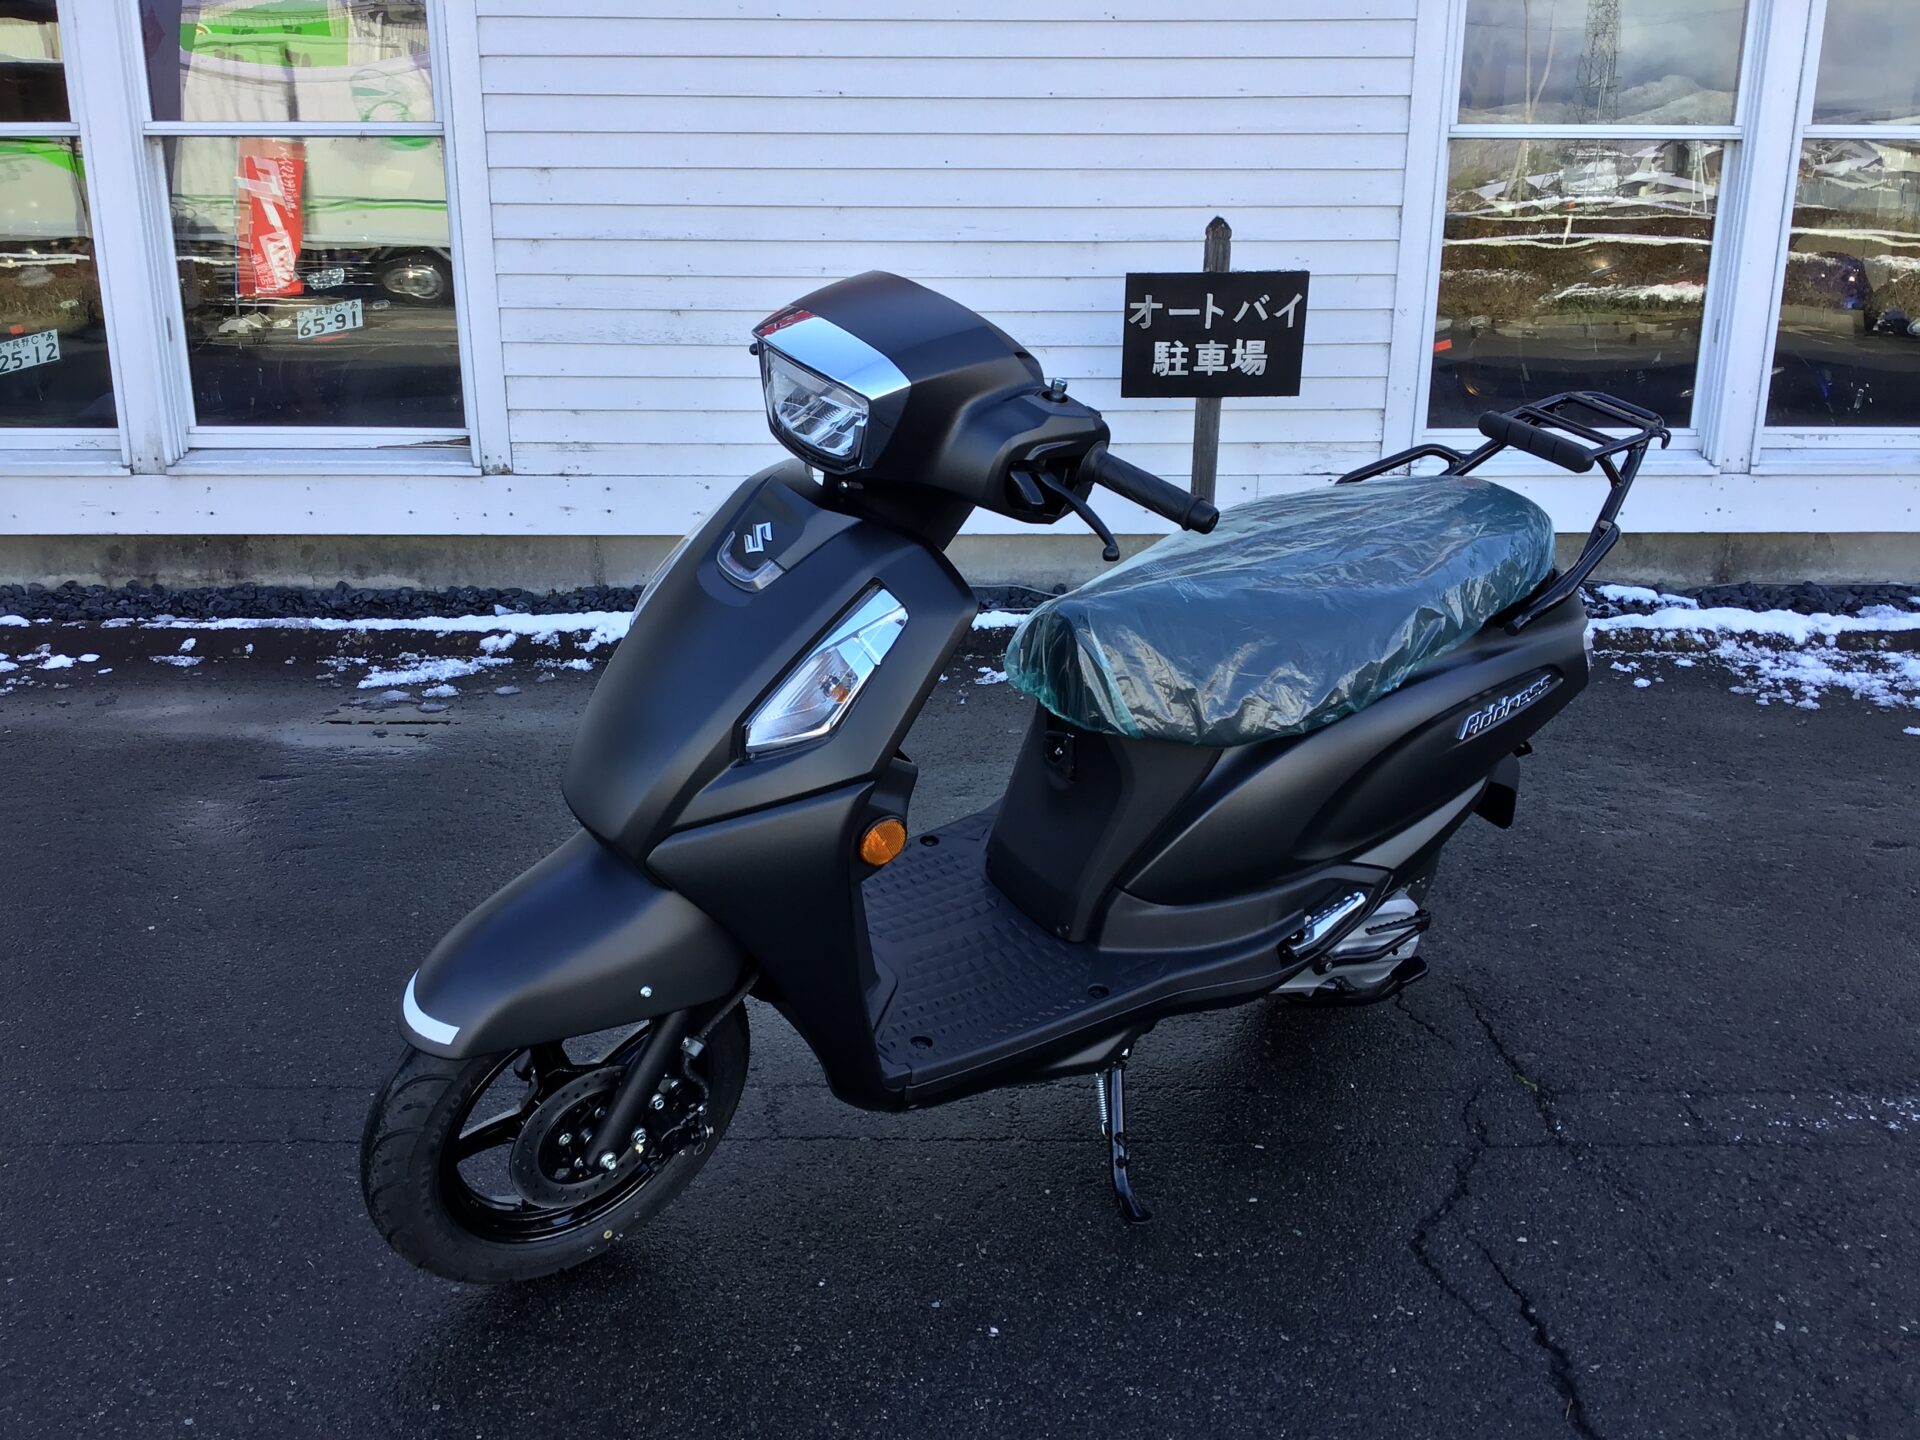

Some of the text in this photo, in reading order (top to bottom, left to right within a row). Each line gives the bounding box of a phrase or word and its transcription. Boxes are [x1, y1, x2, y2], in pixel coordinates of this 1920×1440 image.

[300, 311, 357, 336] 65-91
[1128, 293, 1303, 330] オートバイ
[0, 343, 58, 372] 25-12
[1152, 338, 1268, 376] 駐車場
